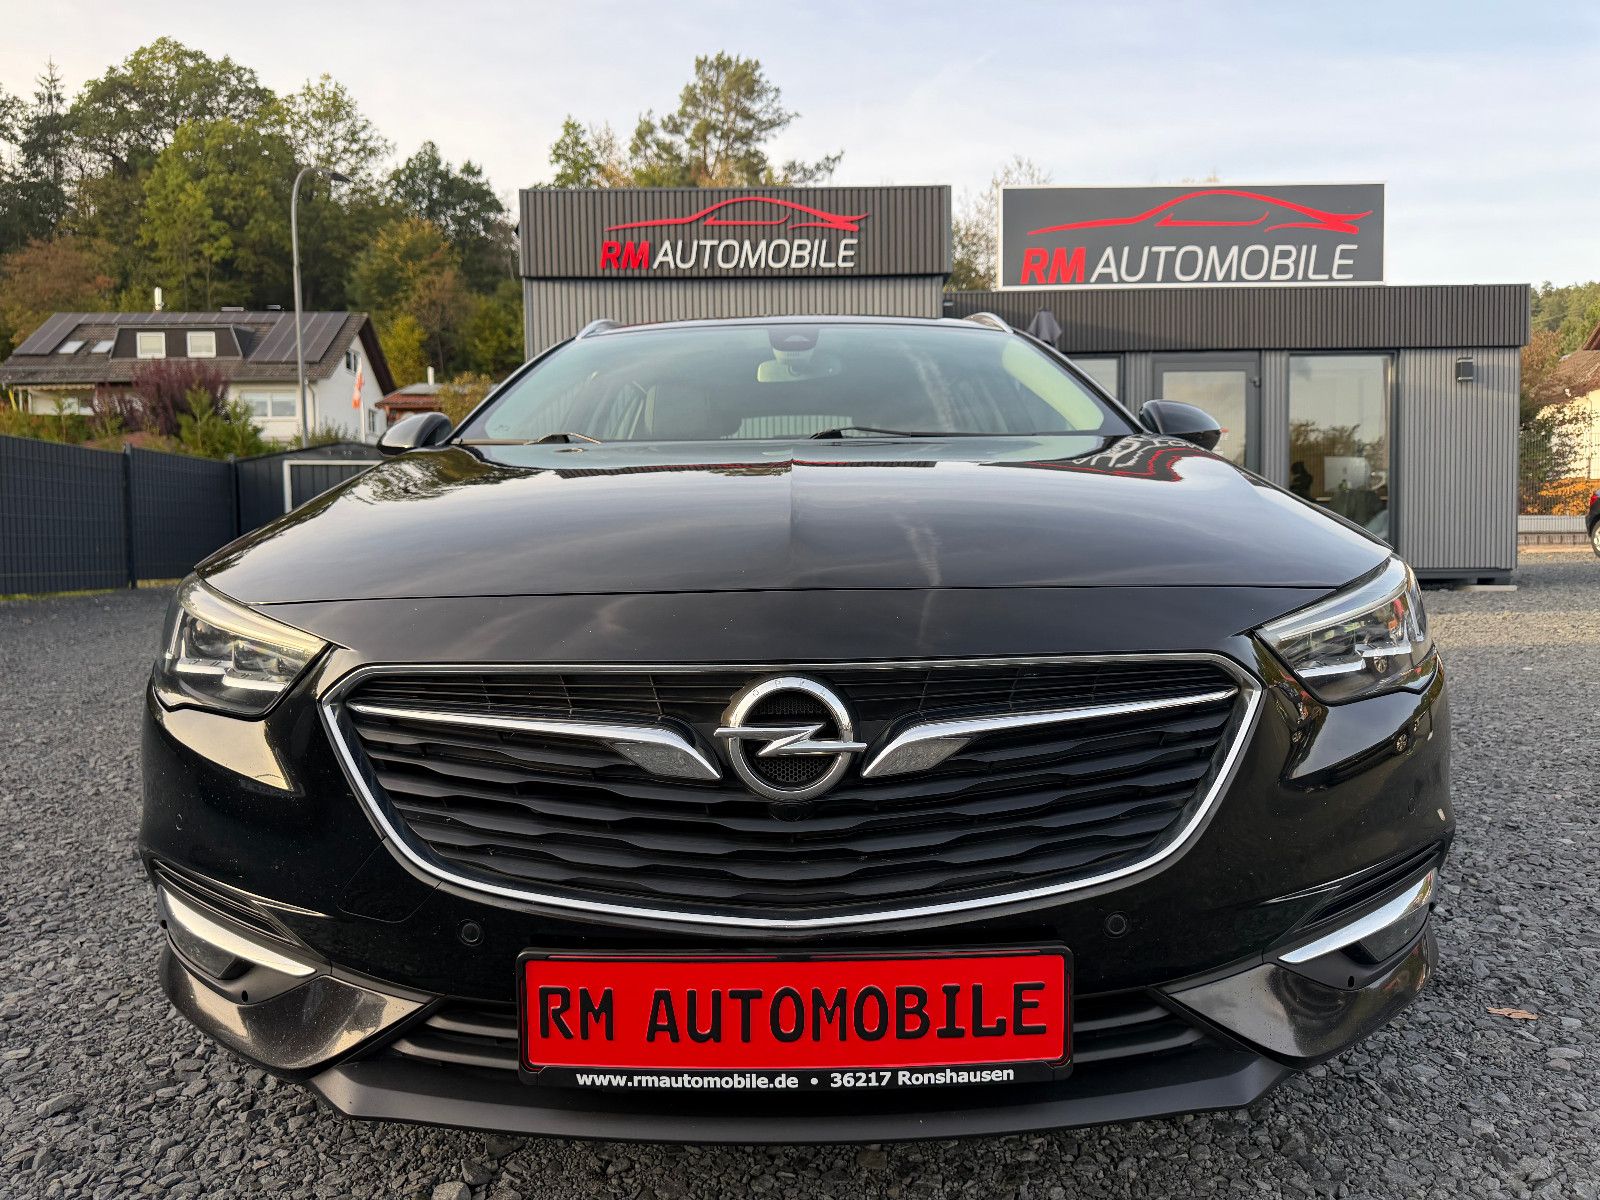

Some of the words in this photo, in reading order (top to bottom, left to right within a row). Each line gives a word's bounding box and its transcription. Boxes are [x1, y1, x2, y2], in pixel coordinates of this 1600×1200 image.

[600, 240, 650, 270] RM
[653, 239, 858, 269] AUTOMOBILE
[1020, 247, 1086, 285] RM
[1090, 244, 1358, 282] AUTOMOBILE
[538, 985, 614, 1041] RM
[647, 981, 1047, 1043] AUTOMOBILE
[576, 1072, 799, 1089] www.rmautomobile.de
[830, 1071, 891, 1088] 36217
[898, 1067, 1014, 1086] Ronshausen
